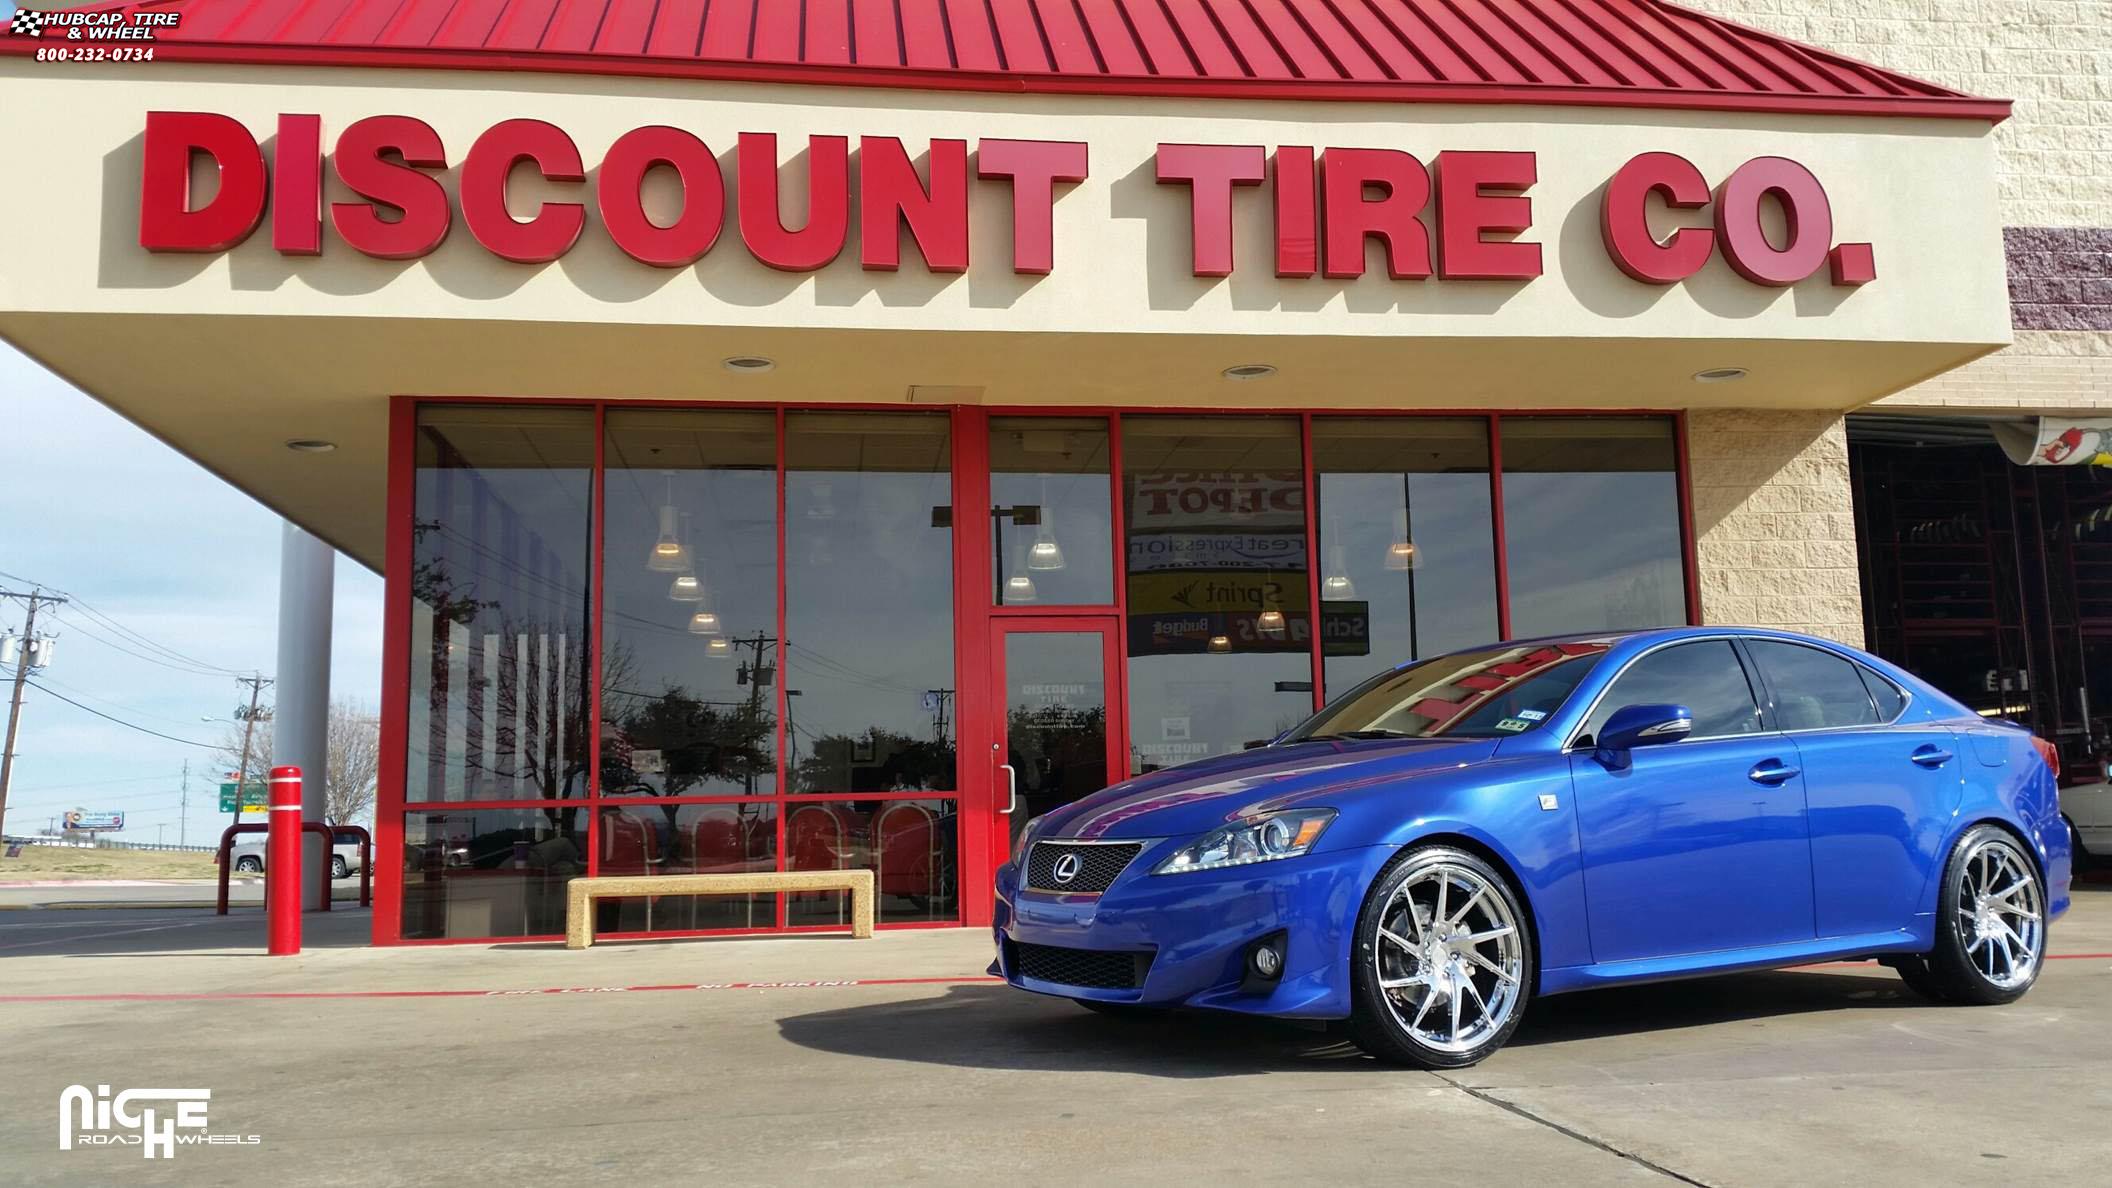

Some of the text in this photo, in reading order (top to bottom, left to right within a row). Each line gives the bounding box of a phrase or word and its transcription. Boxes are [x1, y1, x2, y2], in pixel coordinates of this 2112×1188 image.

[140, 111, 1877, 287] DISCOUNT TIRE CO.
